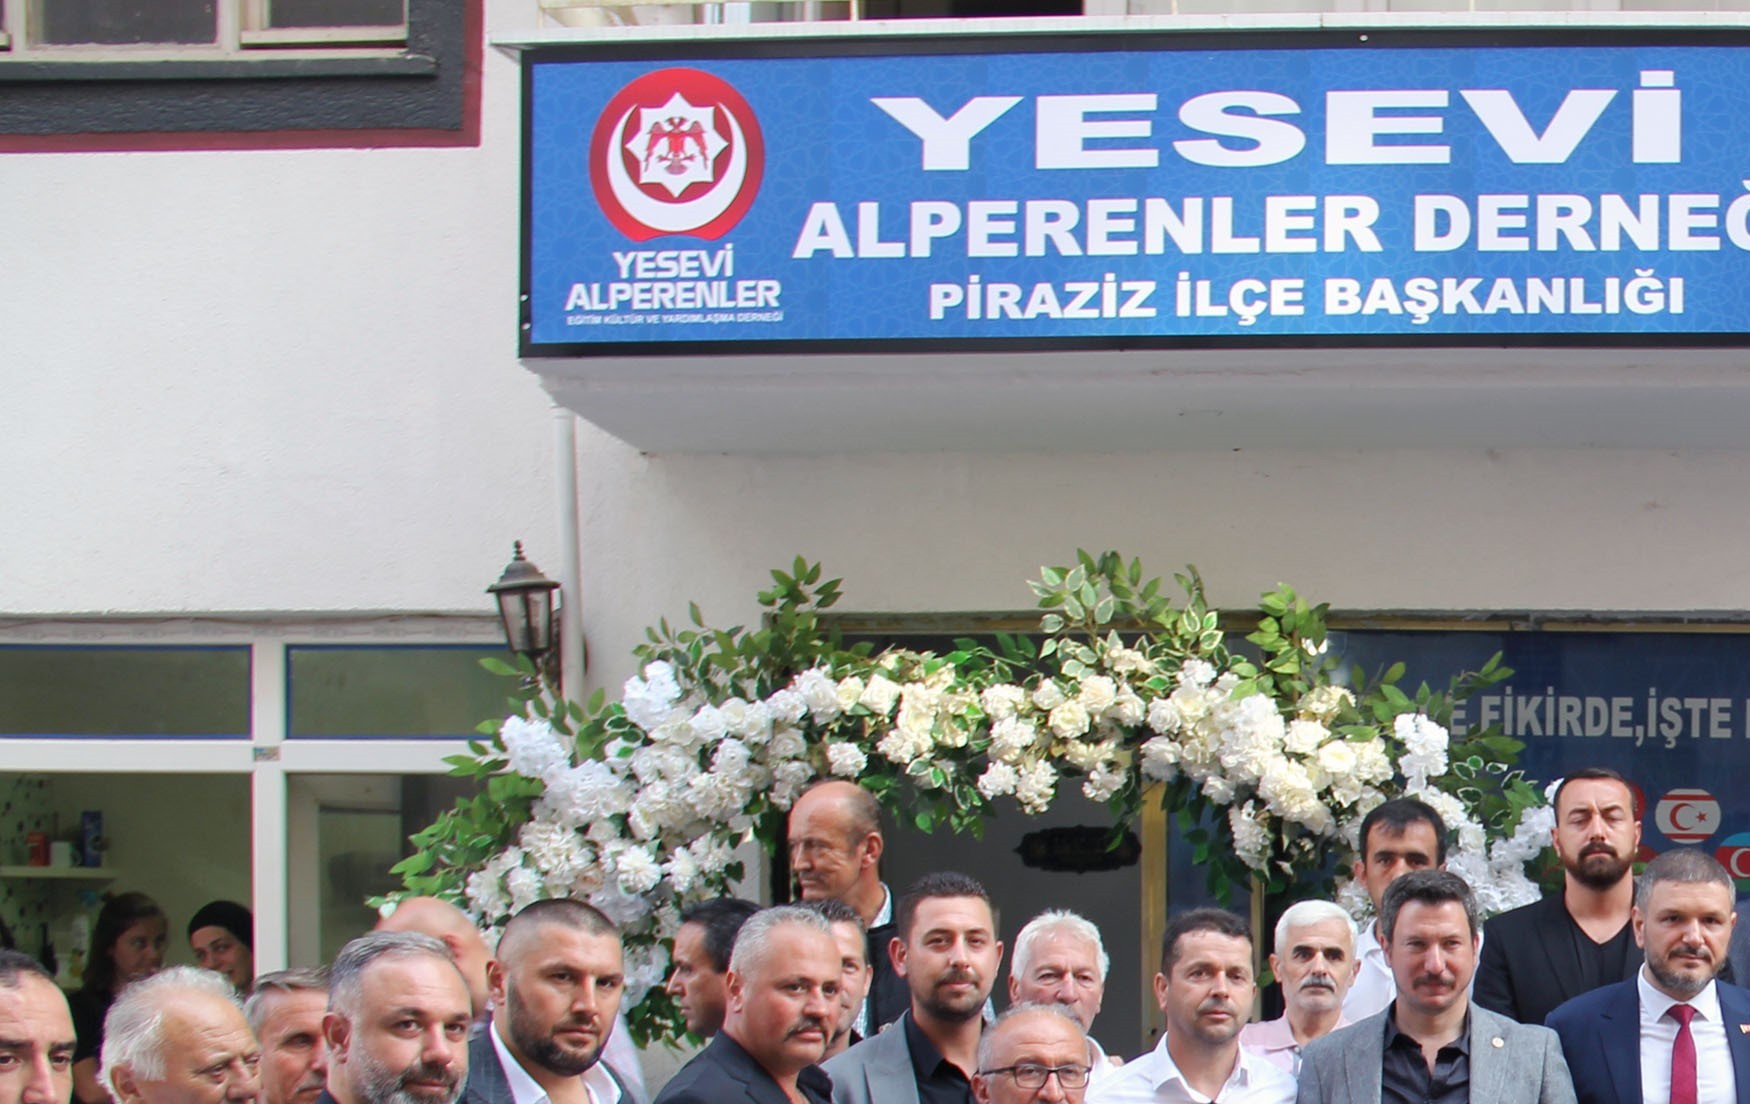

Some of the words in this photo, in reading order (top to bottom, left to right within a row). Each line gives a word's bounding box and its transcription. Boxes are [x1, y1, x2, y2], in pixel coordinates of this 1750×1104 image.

[869, 69, 1682, 171] YESEVİ
[792, 194, 1384, 259] ALPERENLER
[612, 242, 734, 279] YESEVİ
[564, 280, 782, 312] ALPERENLER
[646, 314, 660, 324] VE
[929, 272, 1158, 320] PİRAZİZ
[1175, 271, 1305, 326] İLÇE
[1324, 268, 1685, 325] BAŞKANLIĞI
